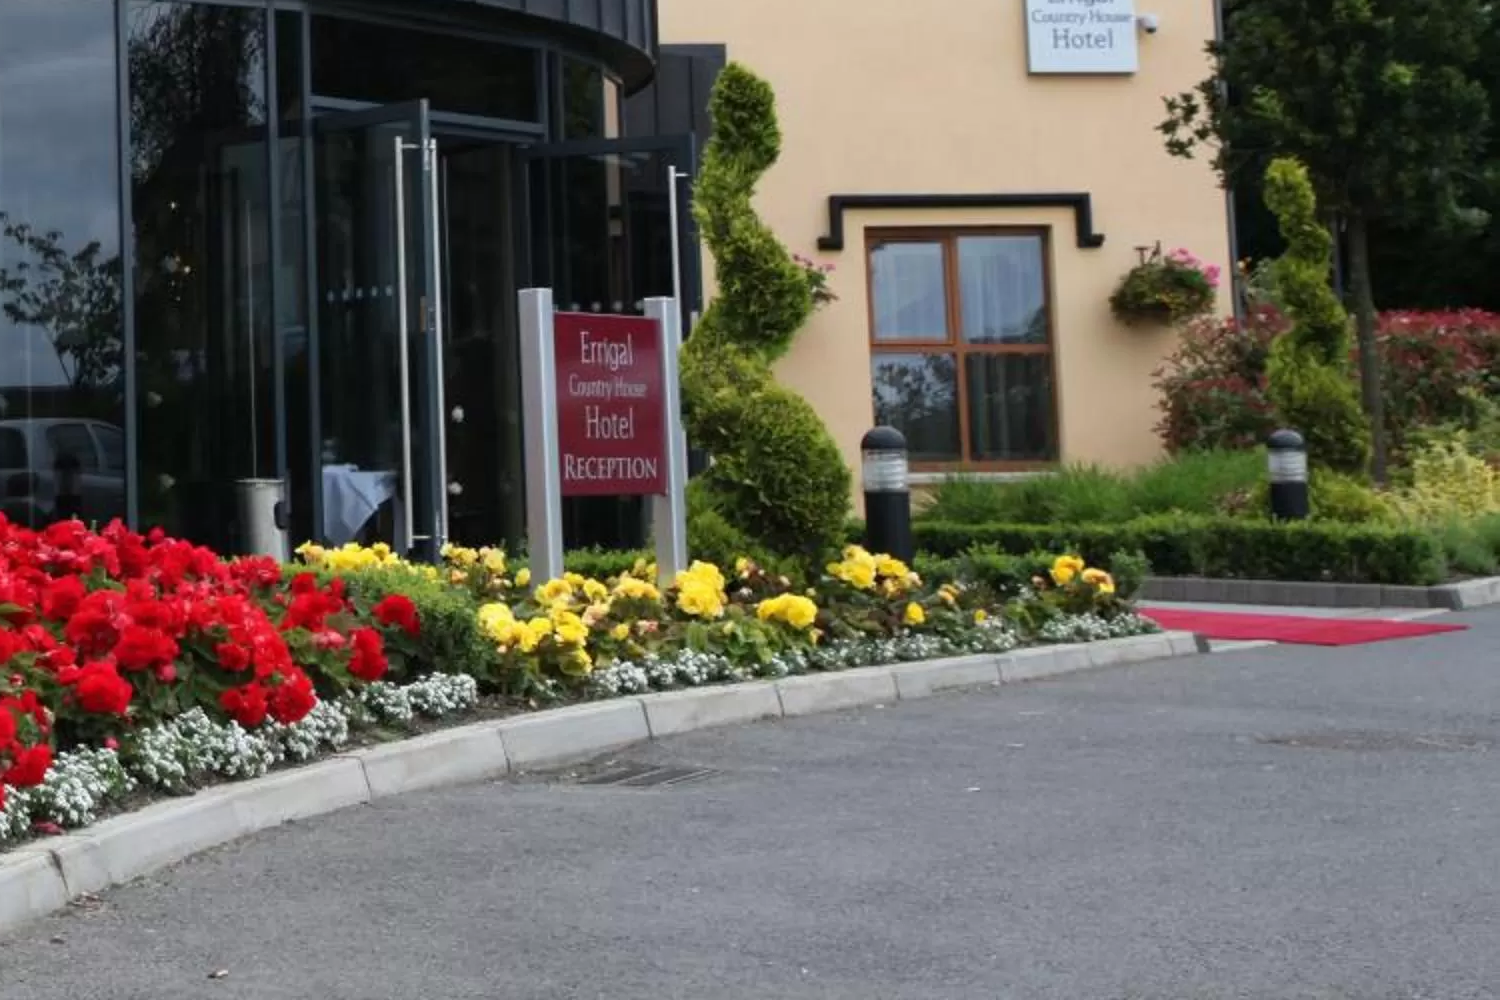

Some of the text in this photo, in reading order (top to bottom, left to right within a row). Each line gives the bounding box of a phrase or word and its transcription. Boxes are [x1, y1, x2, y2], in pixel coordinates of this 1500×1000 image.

[1031, 9, 1132, 27] Country House
[1052, 28, 1114, 50] Hotel
[579, 331, 634, 370] Errigal
[569, 374, 648, 401] Country House
[585, 405, 635, 440] Hotel
[564, 453, 658, 481] RECEPTION
